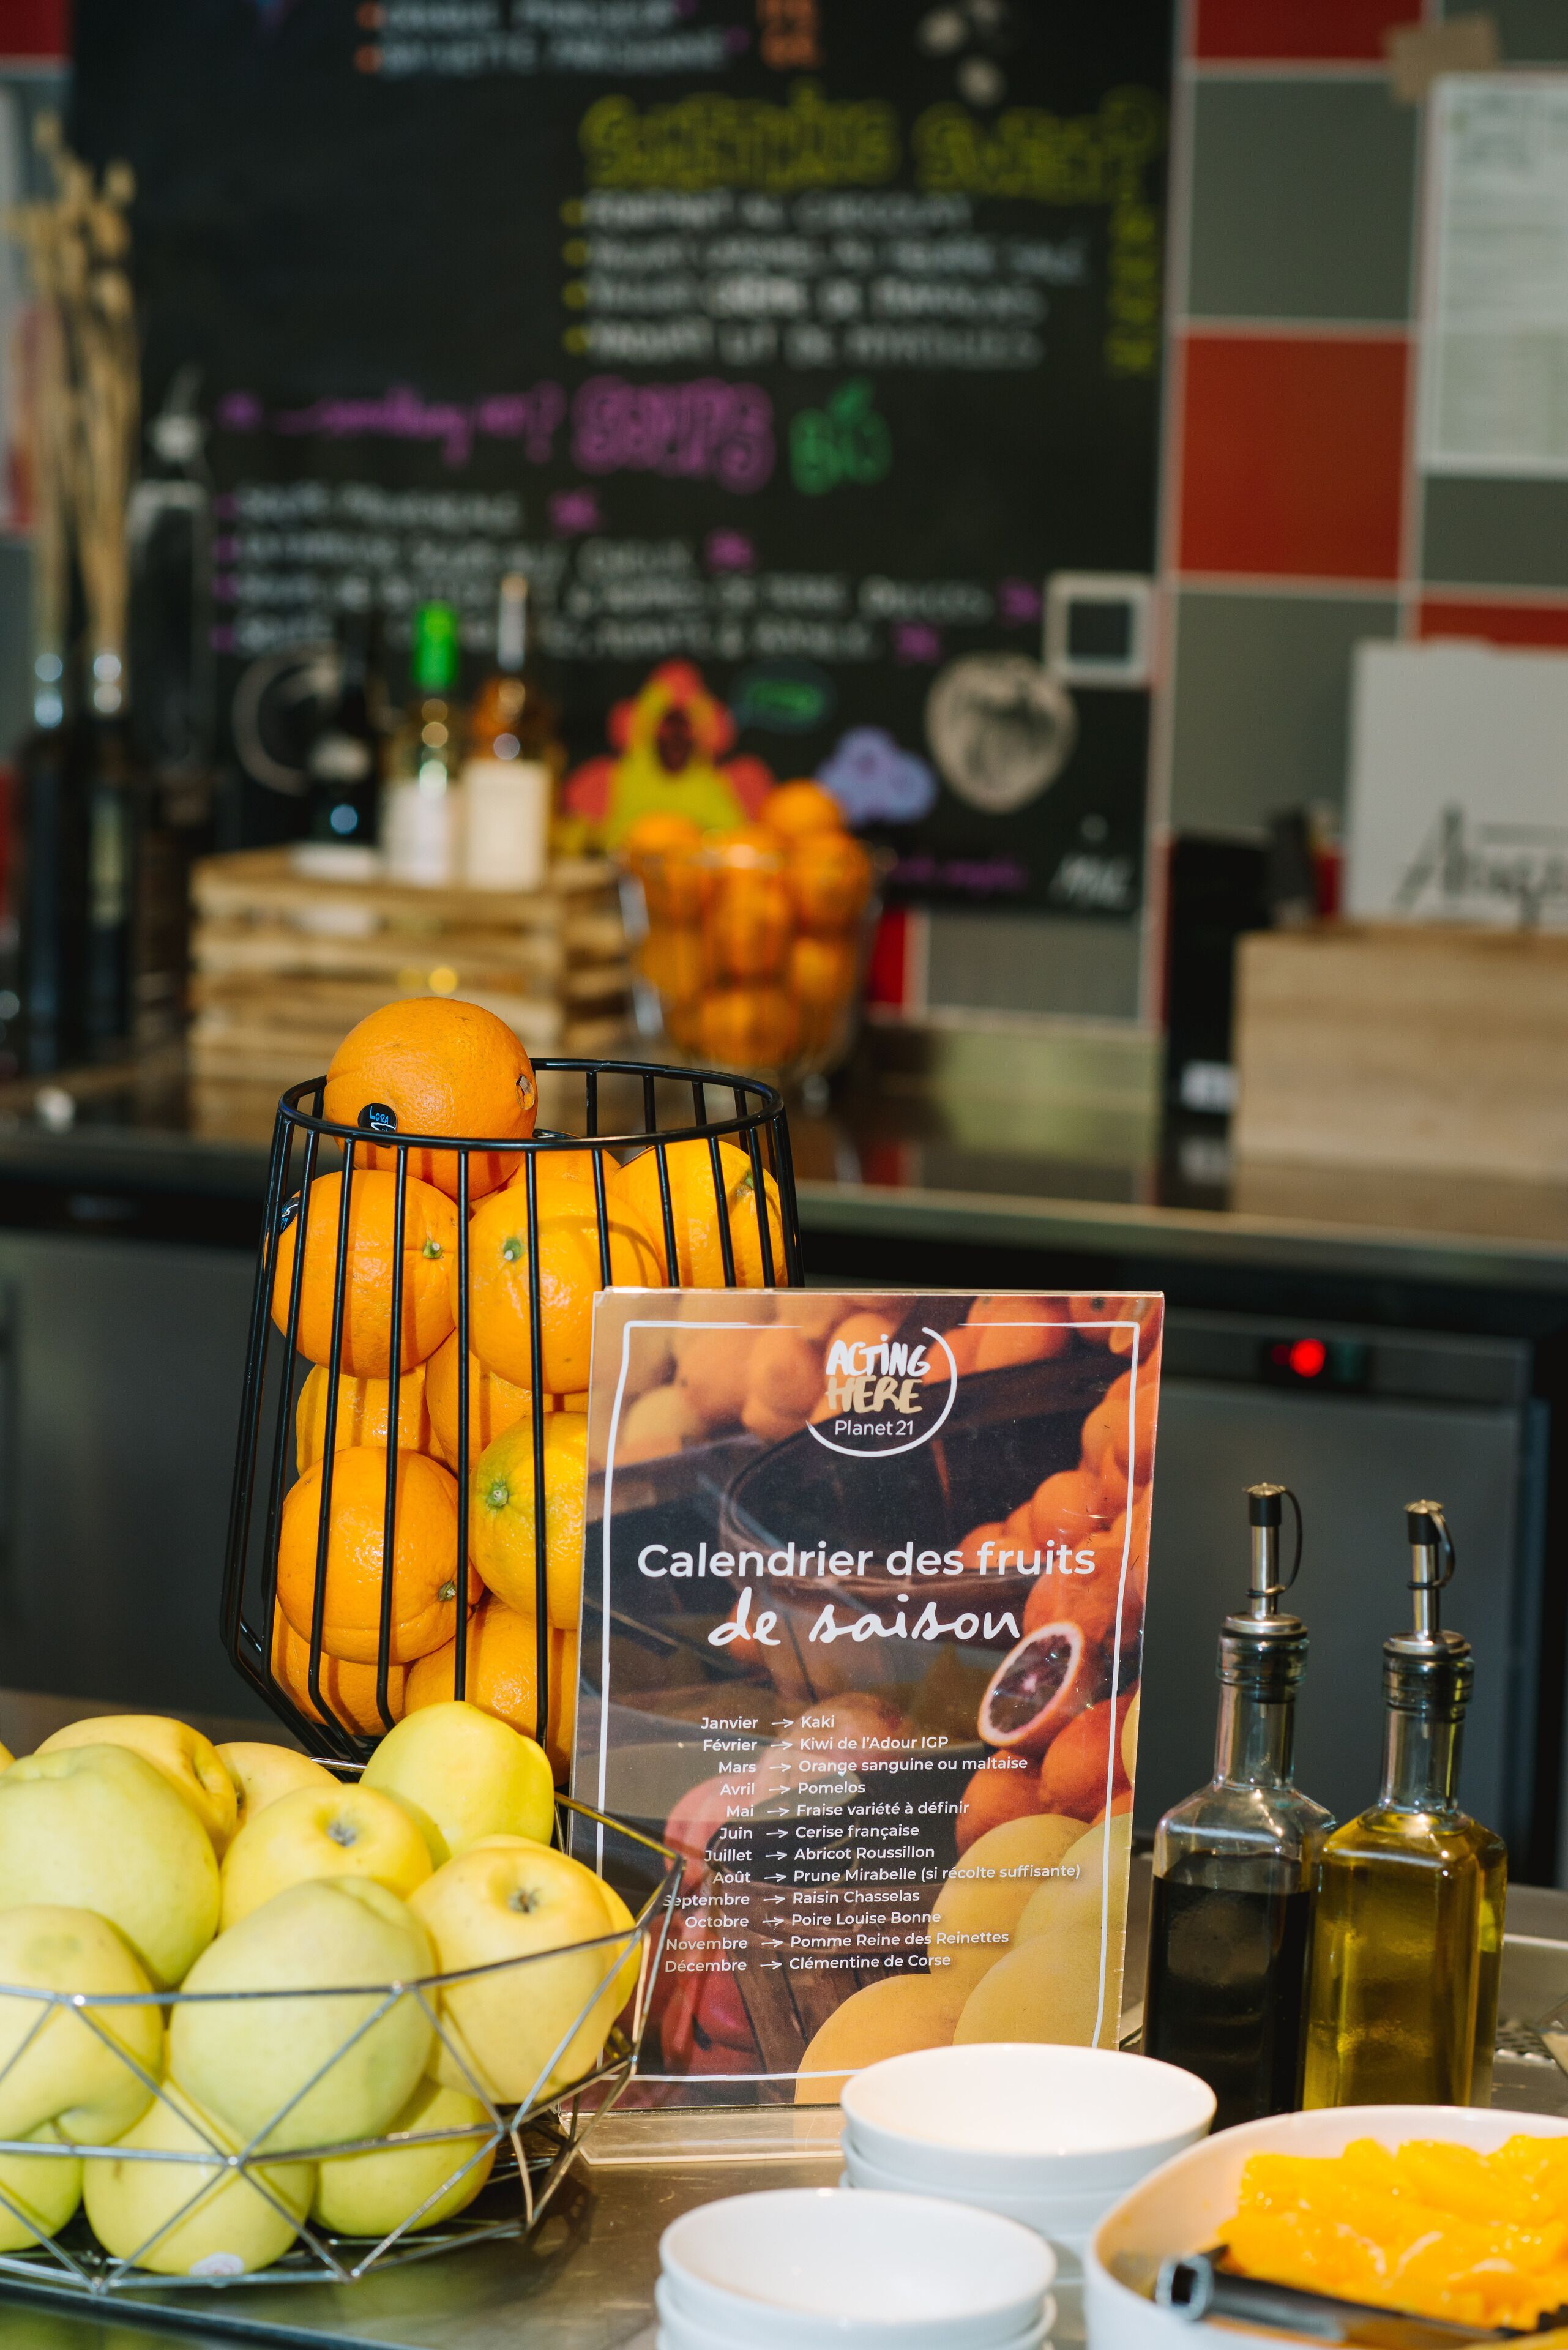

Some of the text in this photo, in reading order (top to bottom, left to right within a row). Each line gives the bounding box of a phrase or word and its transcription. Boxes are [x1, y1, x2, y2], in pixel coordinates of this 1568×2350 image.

[369, 1106, 389, 1124] LORA
[825, 1333, 931, 1377] ACTING
[824, 1375, 923, 1414] HERE
[835, 1420, 913, 1435] Planet 21
[638, 1540, 1095, 1577] Calendrier des fruits
[708, 1587, 1021, 1646] de saison
[701, 1715, 834, 1729] Janvier Kaki
[704, 1738, 757, 1751] Février
[801, 1737, 832, 1750] Kiwi
[838, 1737, 857, 1749] de
[922, 1736, 948, 1748] IGP
[719, 1756, 1027, 1775] Mars Orange sanguine ou maltaise
[720, 1781, 865, 1795] Avril Pomelos
[727, 1801, 969, 1817] Mai Fraise variété à définir
[720, 1824, 919, 1840] Juin Cerise française
[704, 1846, 934, 1861] Juillet Abricot Roussillon
[714, 1865, 1080, 1883] Août Prune Mirabelle (si récolte suffisante)
[793, 1891, 838, 1904] Raisin
[844, 1890, 919, 1902] Chasselas
[685, 1912, 940, 1928] Octobre Poire Louise Bonne
[667, 1931, 1008, 1950] Novembre Pomme Reine des Reinettes
[666, 1955, 950, 1972] Décembre Clémentine de Corse
